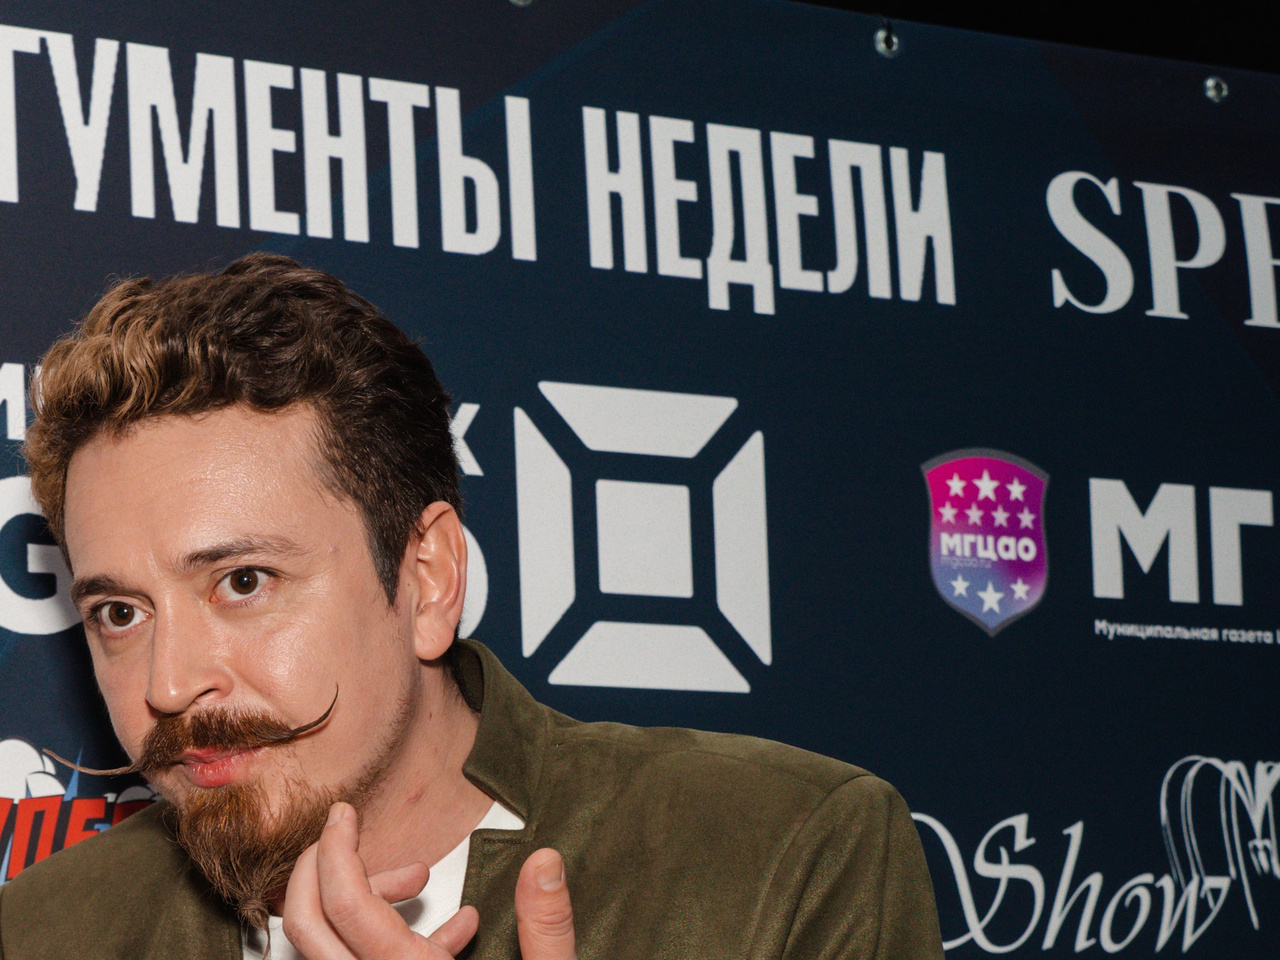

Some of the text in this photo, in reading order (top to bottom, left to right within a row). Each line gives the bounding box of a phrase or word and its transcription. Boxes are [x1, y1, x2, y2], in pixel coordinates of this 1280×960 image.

[582, 105, 957, 315] НЕДЕЛИ
[1093, 618, 1219, 642] Муниципальная
[1221, 627, 1274, 645] газета
